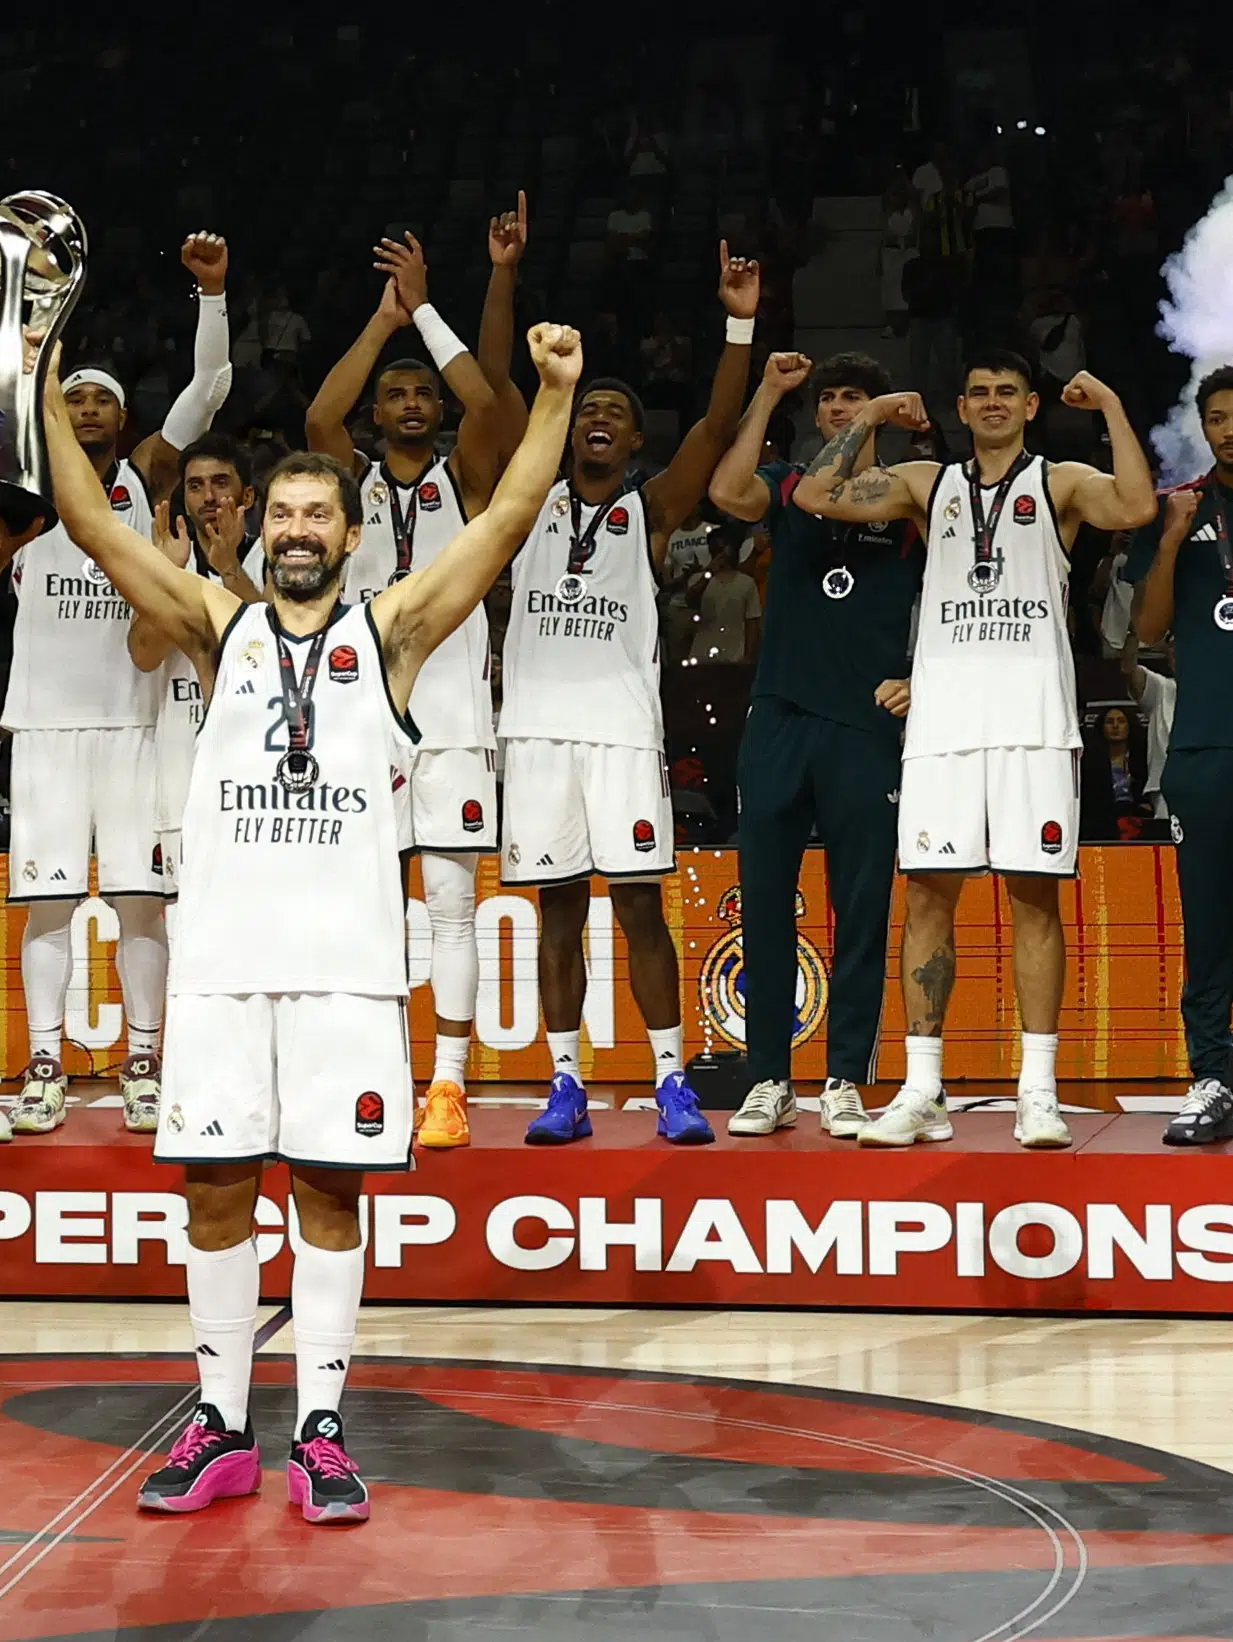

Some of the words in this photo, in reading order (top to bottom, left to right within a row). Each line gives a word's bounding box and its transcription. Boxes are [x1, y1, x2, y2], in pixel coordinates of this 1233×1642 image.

[58, 600, 80, 620] FLY
[941, 596, 1049, 625] Emirates
[539, 616, 560, 637] FLY
[564, 617, 615, 642] BETTER
[952, 623, 974, 644] FLY
[979, 621, 1032, 643] BETTER
[219, 778, 368, 814] Emirates
[234, 817, 264, 844] FLY
[270, 817, 342, 846] BETTER
[484, 1193, 1233, 1284] CHAMPIONS
